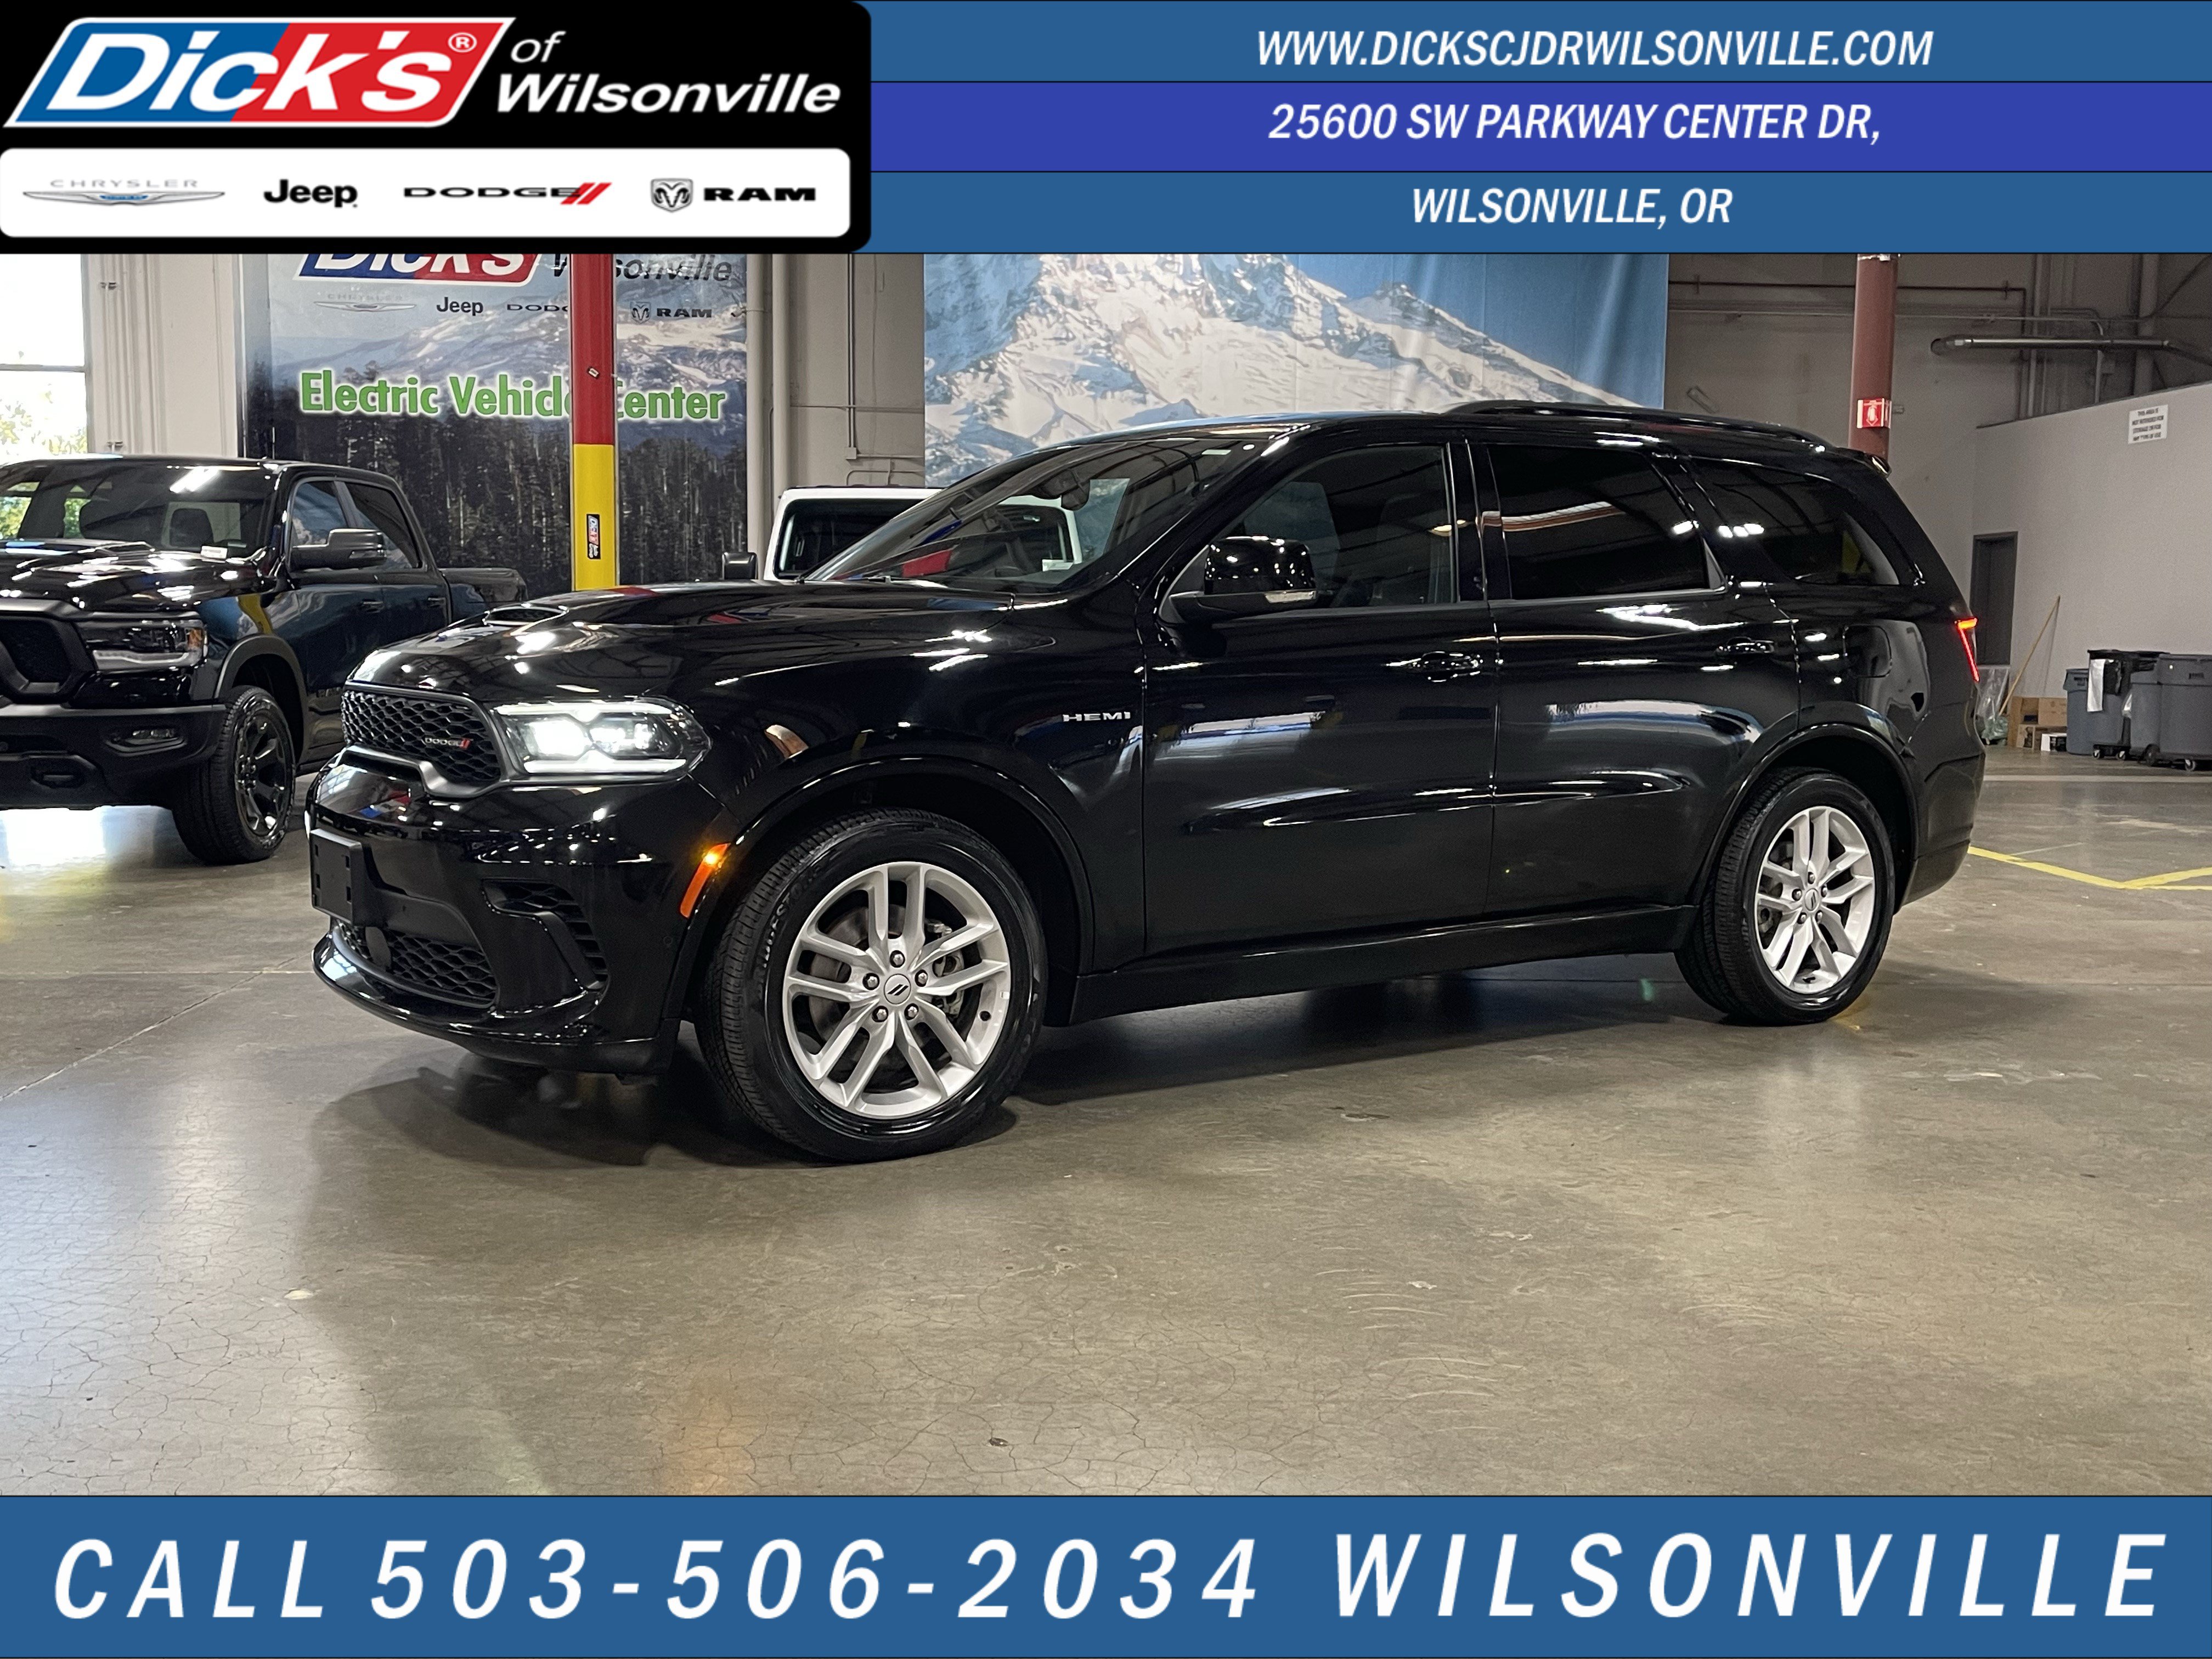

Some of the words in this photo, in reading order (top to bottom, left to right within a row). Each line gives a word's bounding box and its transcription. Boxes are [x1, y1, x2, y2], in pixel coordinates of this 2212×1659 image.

[436, 297, 483, 316] Jeep
[506, 303, 568, 312] DOD
[656, 308, 712, 318] RAM
[301, 370, 438, 414] Electric
[449, 375, 571, 416] Vehicl
[617, 380, 726, 419] enter
[1063, 712, 1131, 722] HEMI
